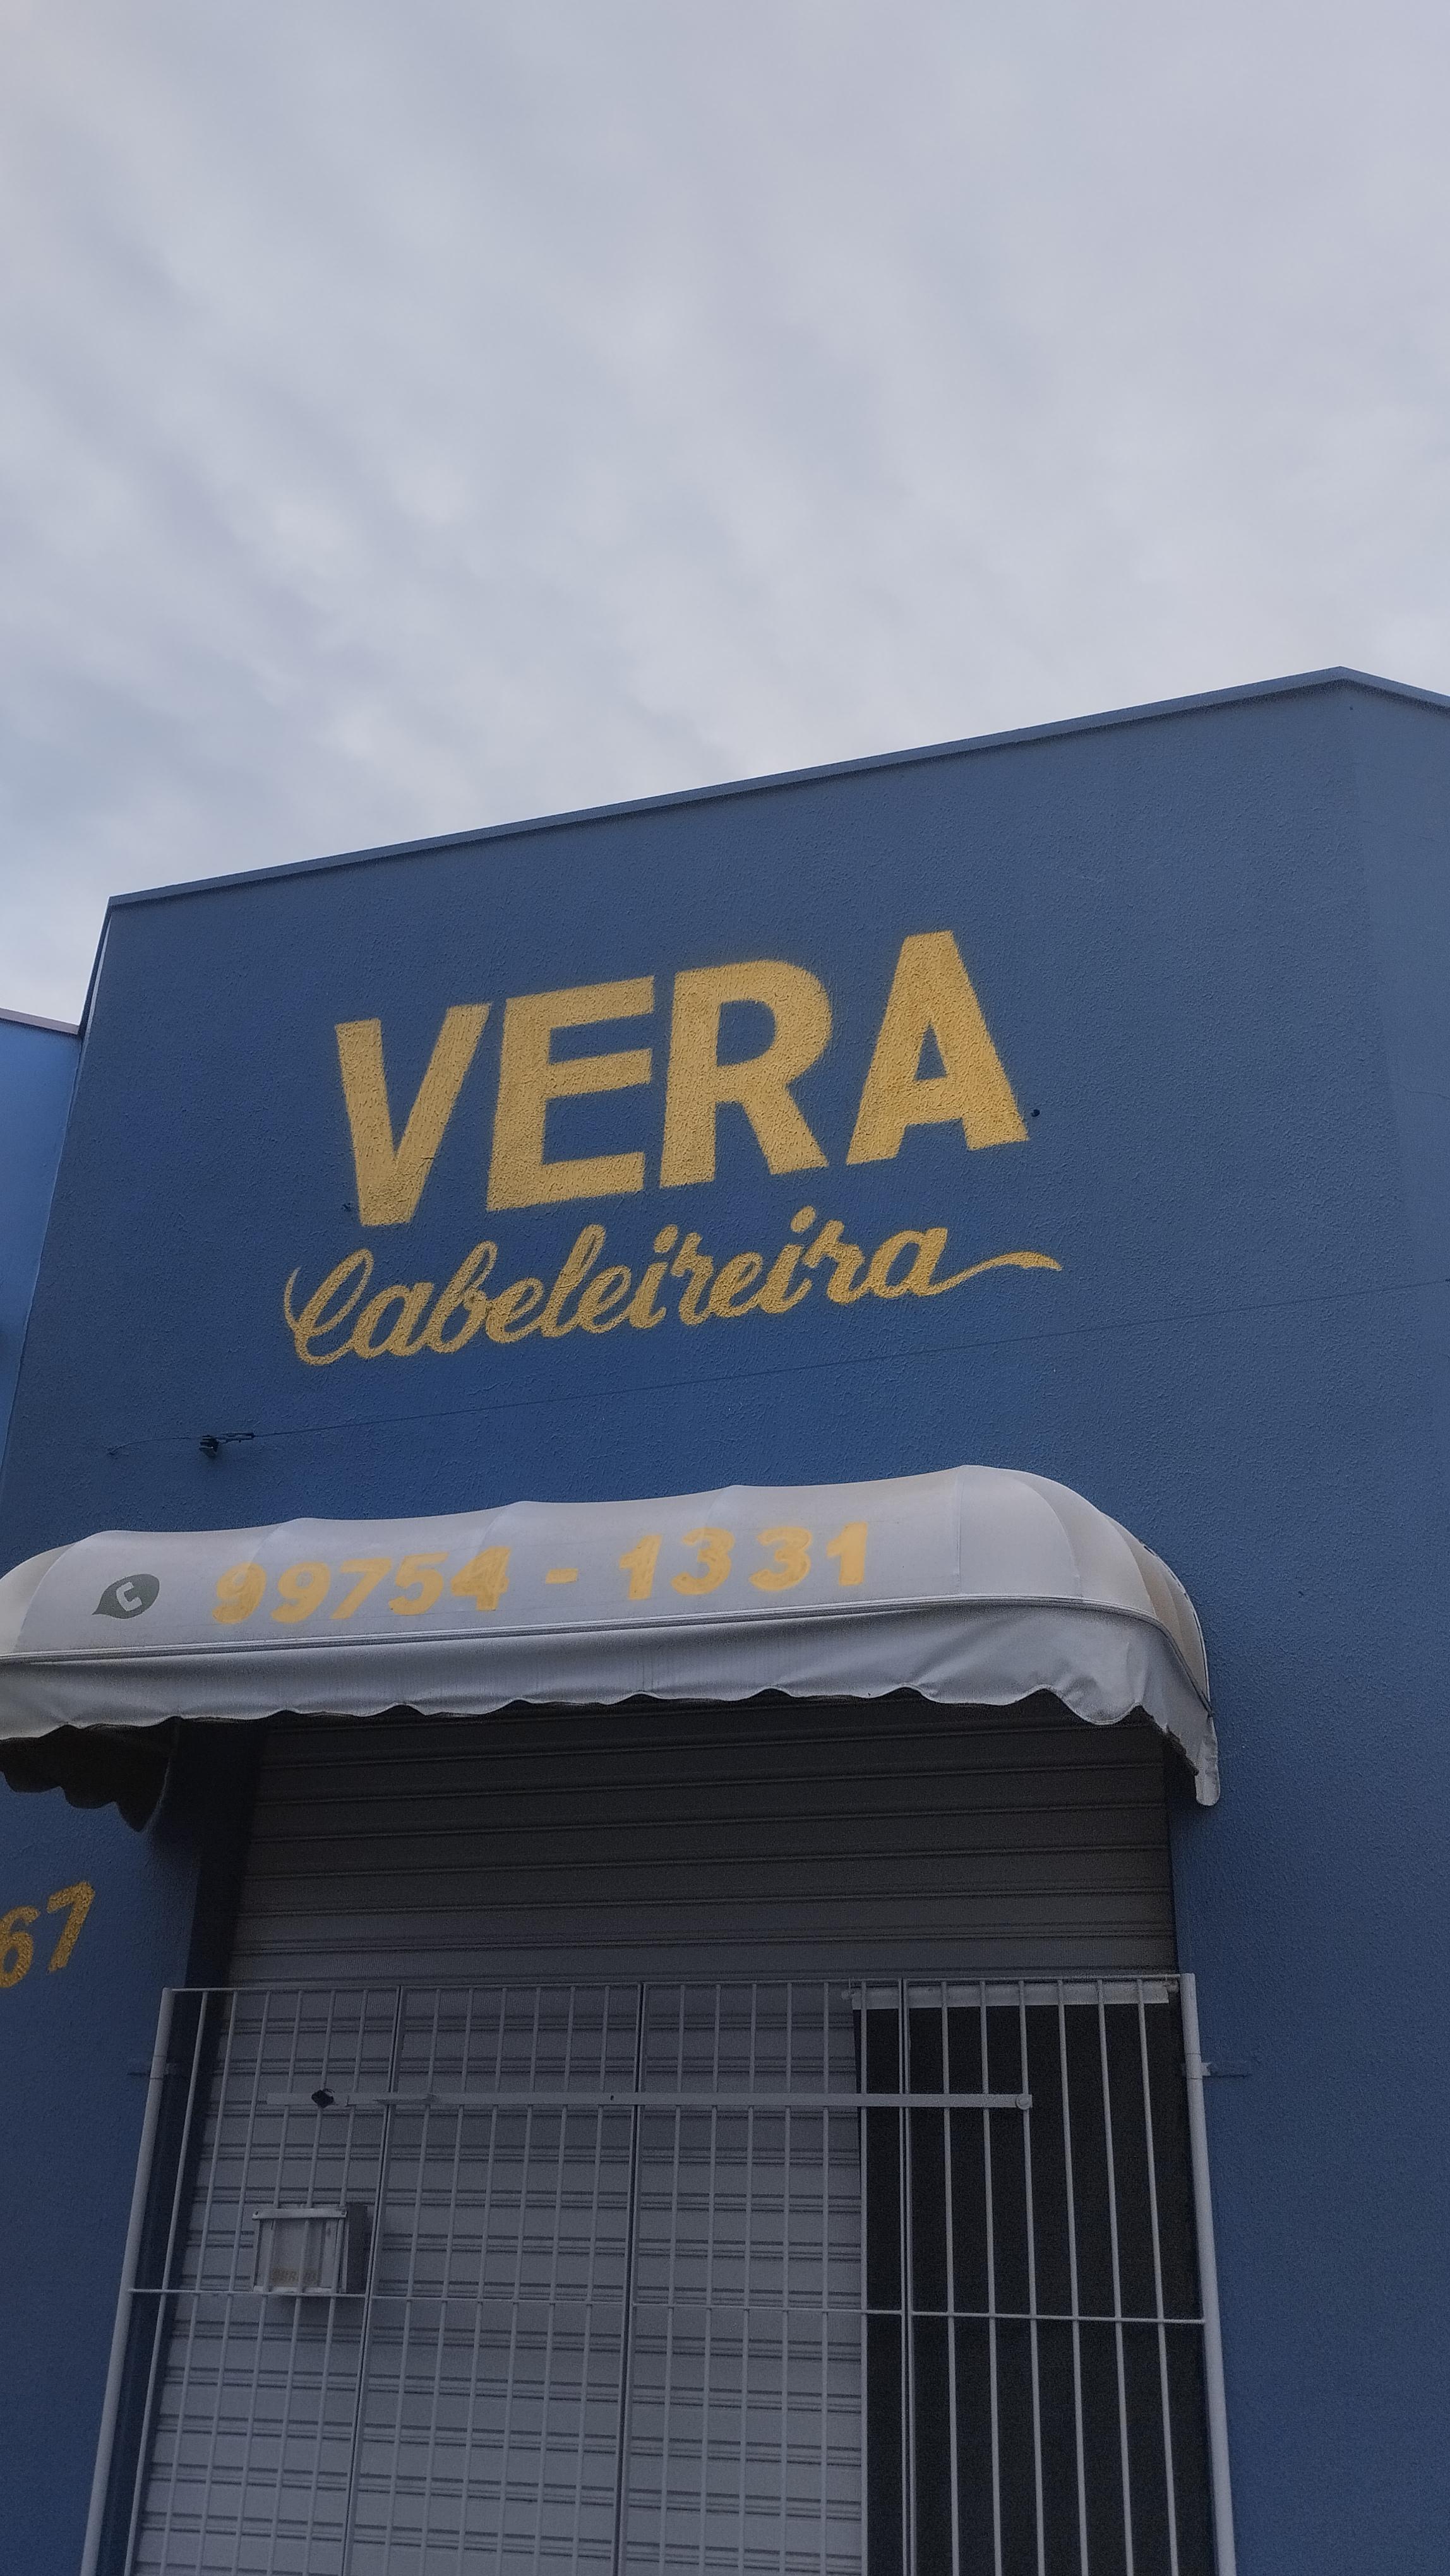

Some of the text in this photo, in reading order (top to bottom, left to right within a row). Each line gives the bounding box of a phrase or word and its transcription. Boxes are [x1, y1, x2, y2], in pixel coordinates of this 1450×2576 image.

[335, 930, 1030, 1226] VERA
[284, 1206, 1063, 1366] Cabeleireira
[211, 1546, 512, 1625] 99754
[619, 1521, 868, 1601] 1331
